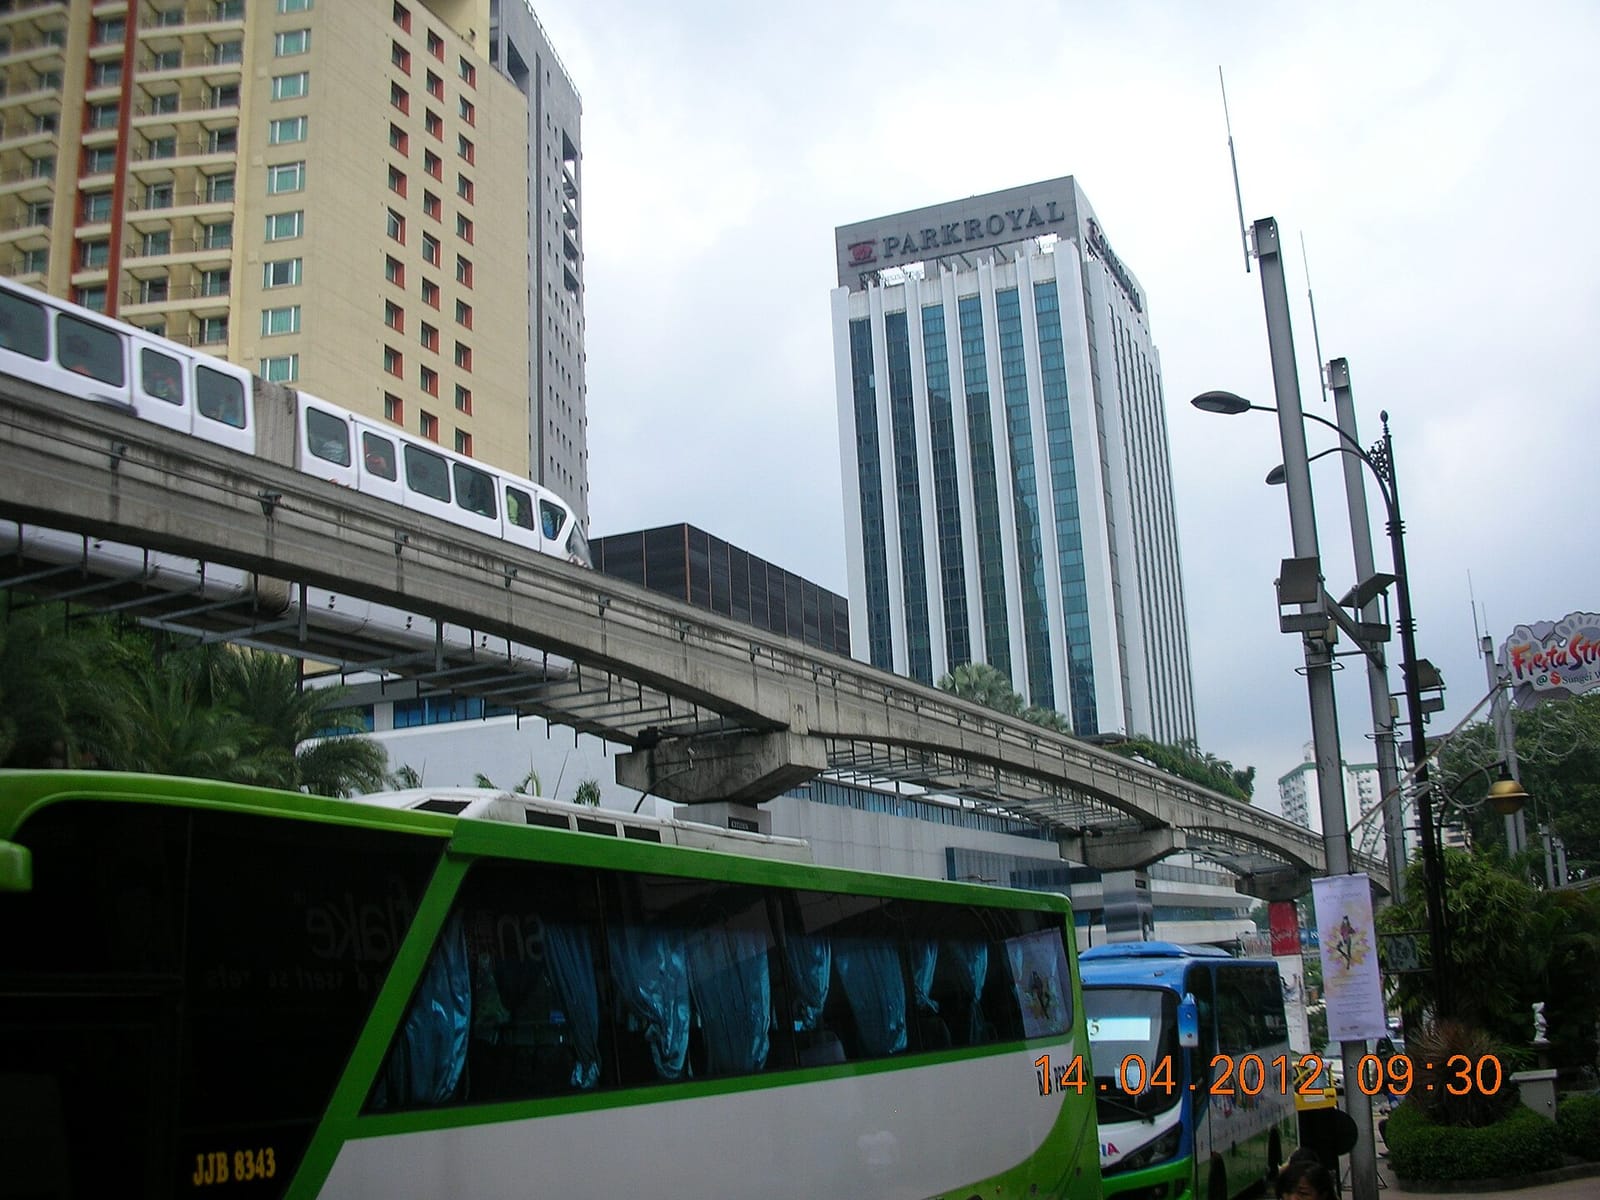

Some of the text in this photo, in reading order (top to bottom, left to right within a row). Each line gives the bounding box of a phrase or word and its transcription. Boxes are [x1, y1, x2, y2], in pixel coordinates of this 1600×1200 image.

[882, 201, 1065, 258] PARKROYAL
[1568, 634, 1600, 671] Str
[1562, 672, 1593, 685] Sungei
[192, 1146, 277, 1186] JJB 8343
